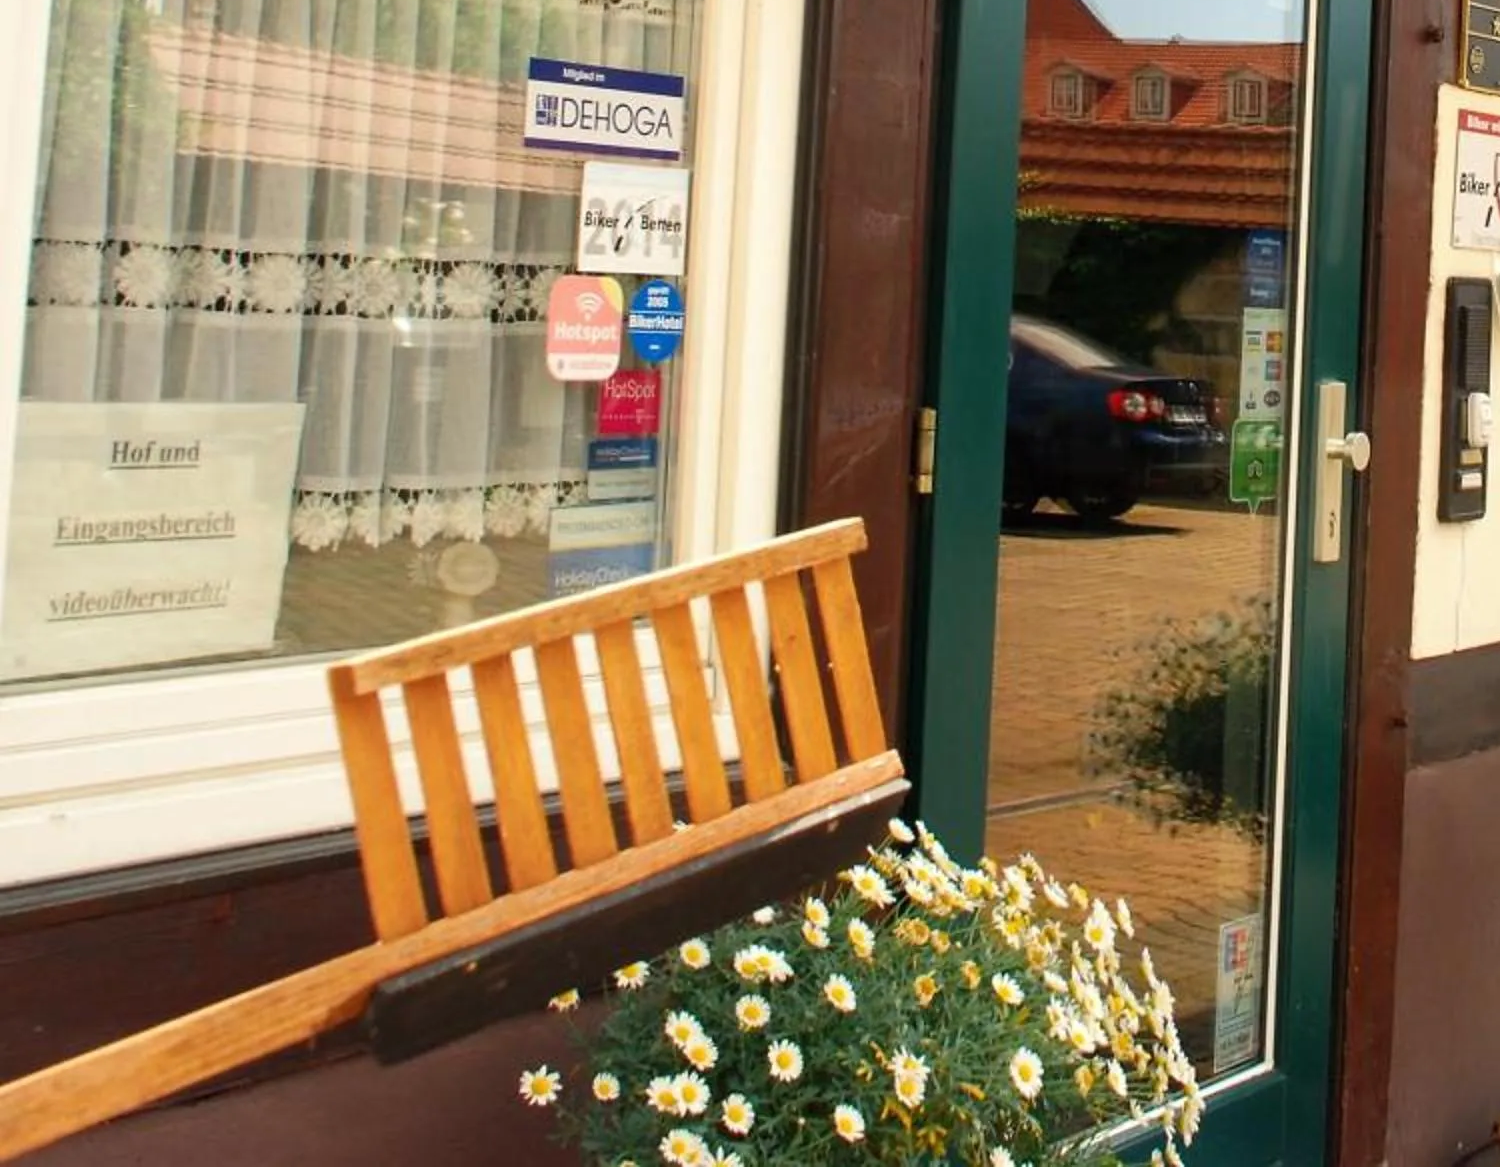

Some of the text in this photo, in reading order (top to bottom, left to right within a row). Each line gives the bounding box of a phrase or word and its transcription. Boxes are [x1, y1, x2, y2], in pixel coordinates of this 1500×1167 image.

[560, 96, 673, 139] DEHOGA
[1459, 172, 1491, 196] Biker
[584, 210, 682, 233] Biker Betten
[553, 321, 618, 345] Hotspot
[604, 378, 657, 403] HotSpot
[111, 439, 200, 464] Hof und
[55, 510, 236, 542] Eingangsbereich
[49, 581, 231, 617] videoüberwacht!
